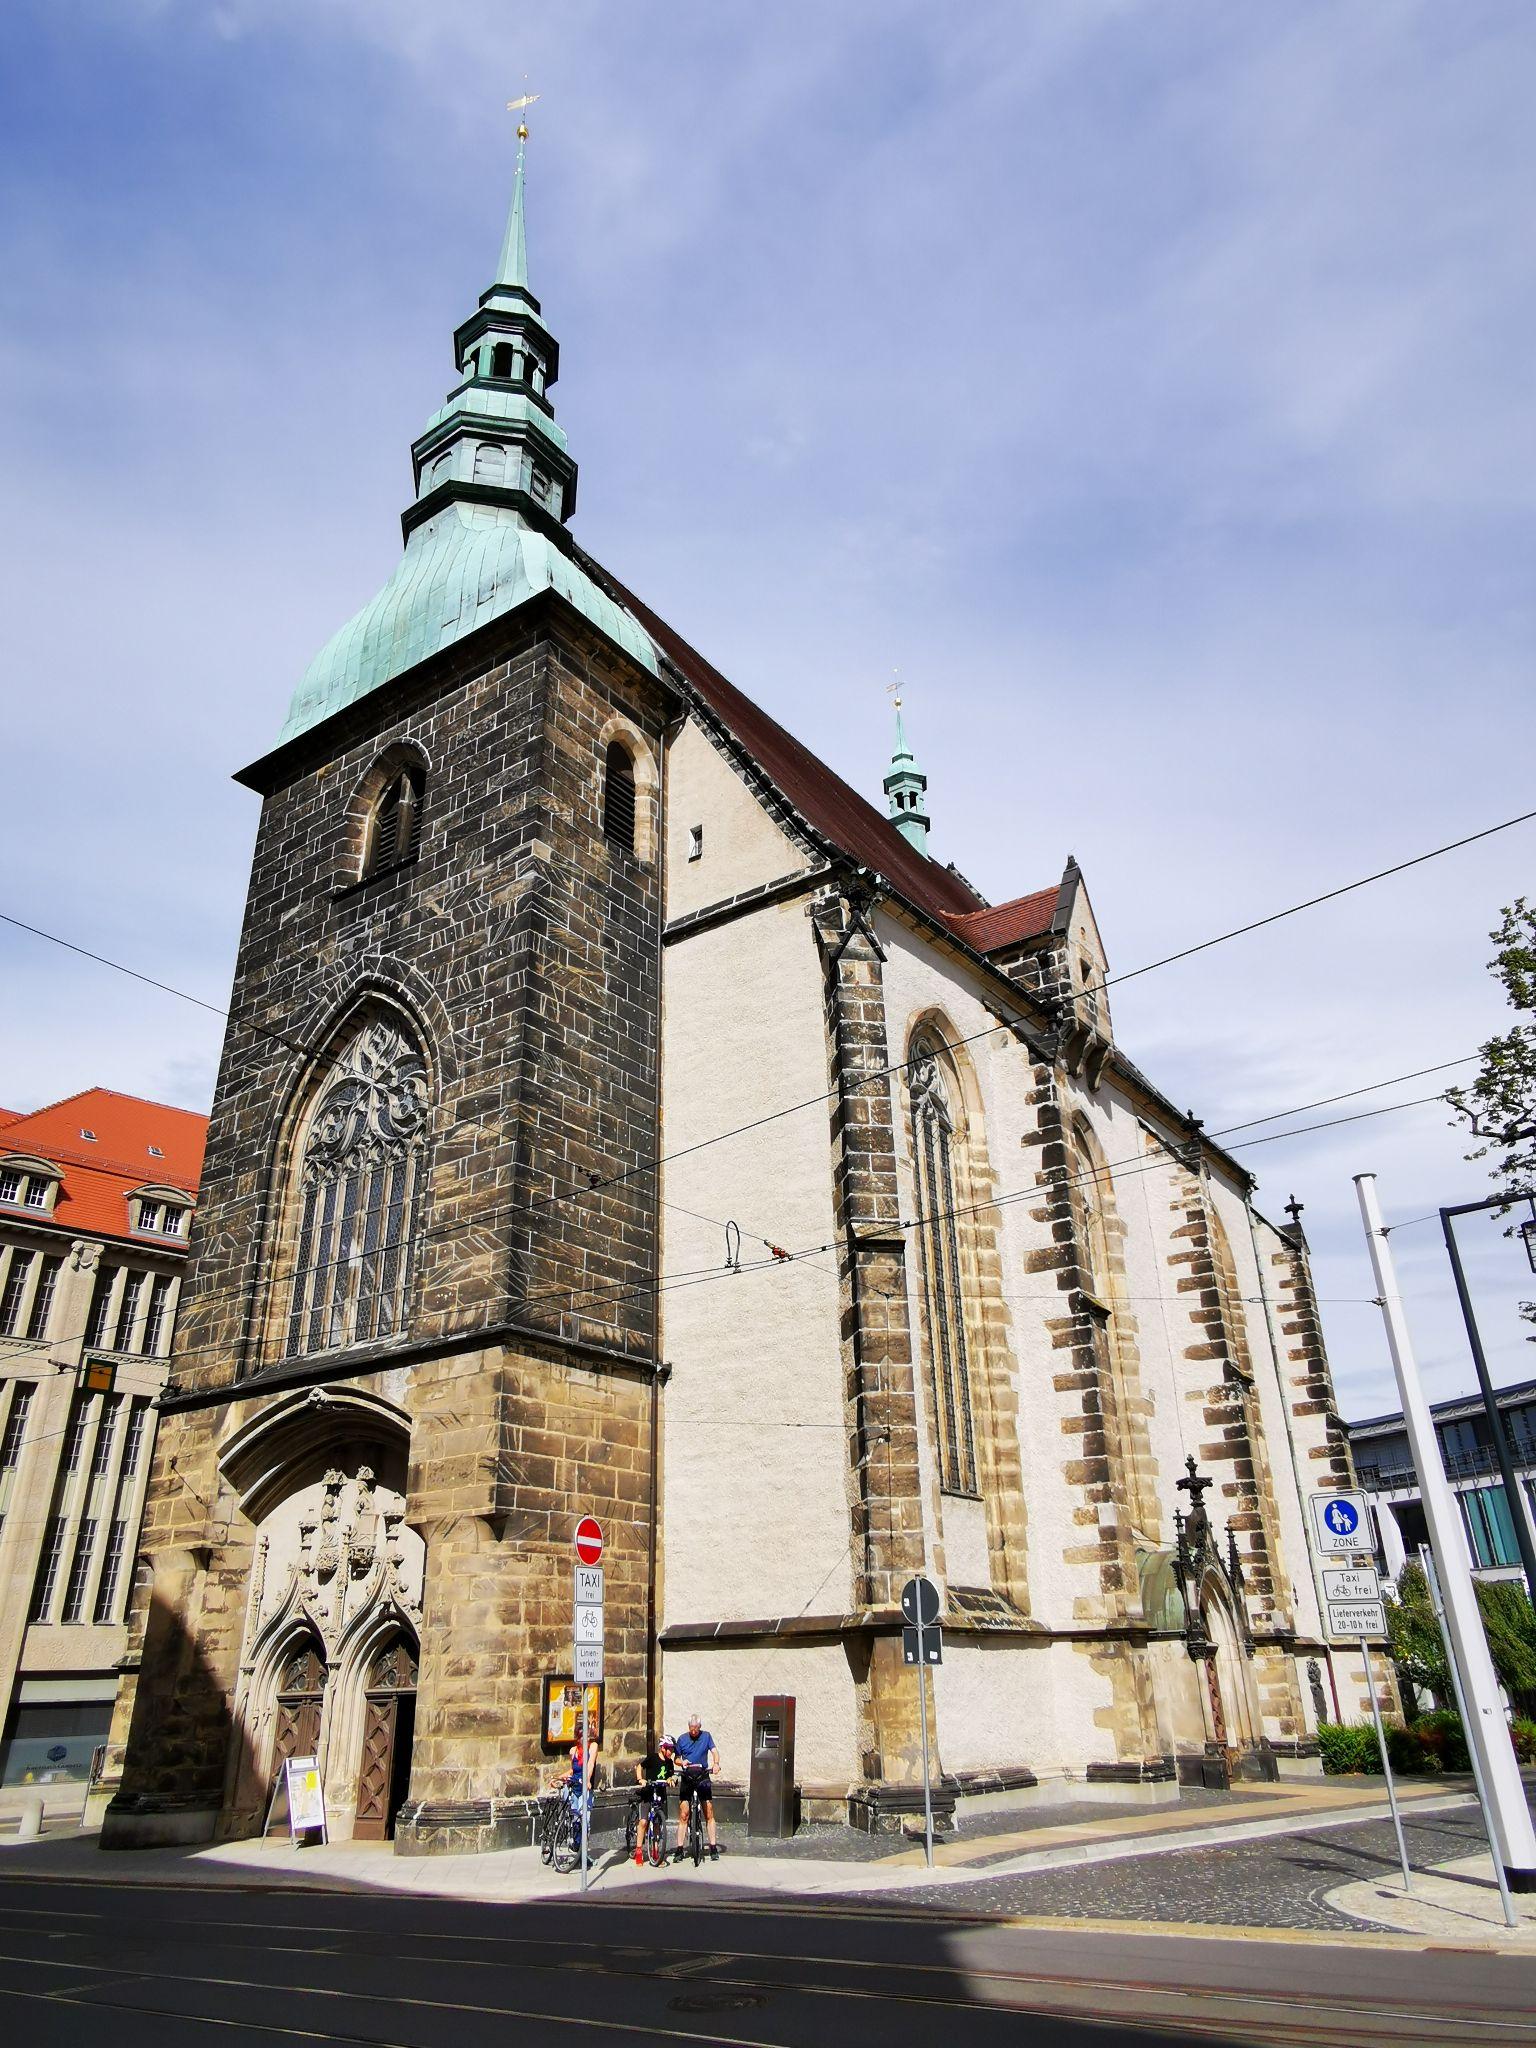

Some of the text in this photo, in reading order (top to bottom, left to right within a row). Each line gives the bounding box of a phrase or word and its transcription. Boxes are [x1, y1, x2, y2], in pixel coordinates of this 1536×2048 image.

[1333, 1537, 1359, 1548] ZONE
[580, 1573, 600, 1588] TAXI
[1340, 1573, 1360, 1583] Taxi
[1355, 1585, 1372, 1595] frei
[1332, 1608, 1378, 1618] Lieferverkehr
[1365, 1620, 1378, 1629] frei
[585, 1630, 595, 1638] frei
[580, 1649, 599, 1657] Linien-
[580, 1660, 599, 1668] verkehr
[585, 1670, 595, 1678] frei
